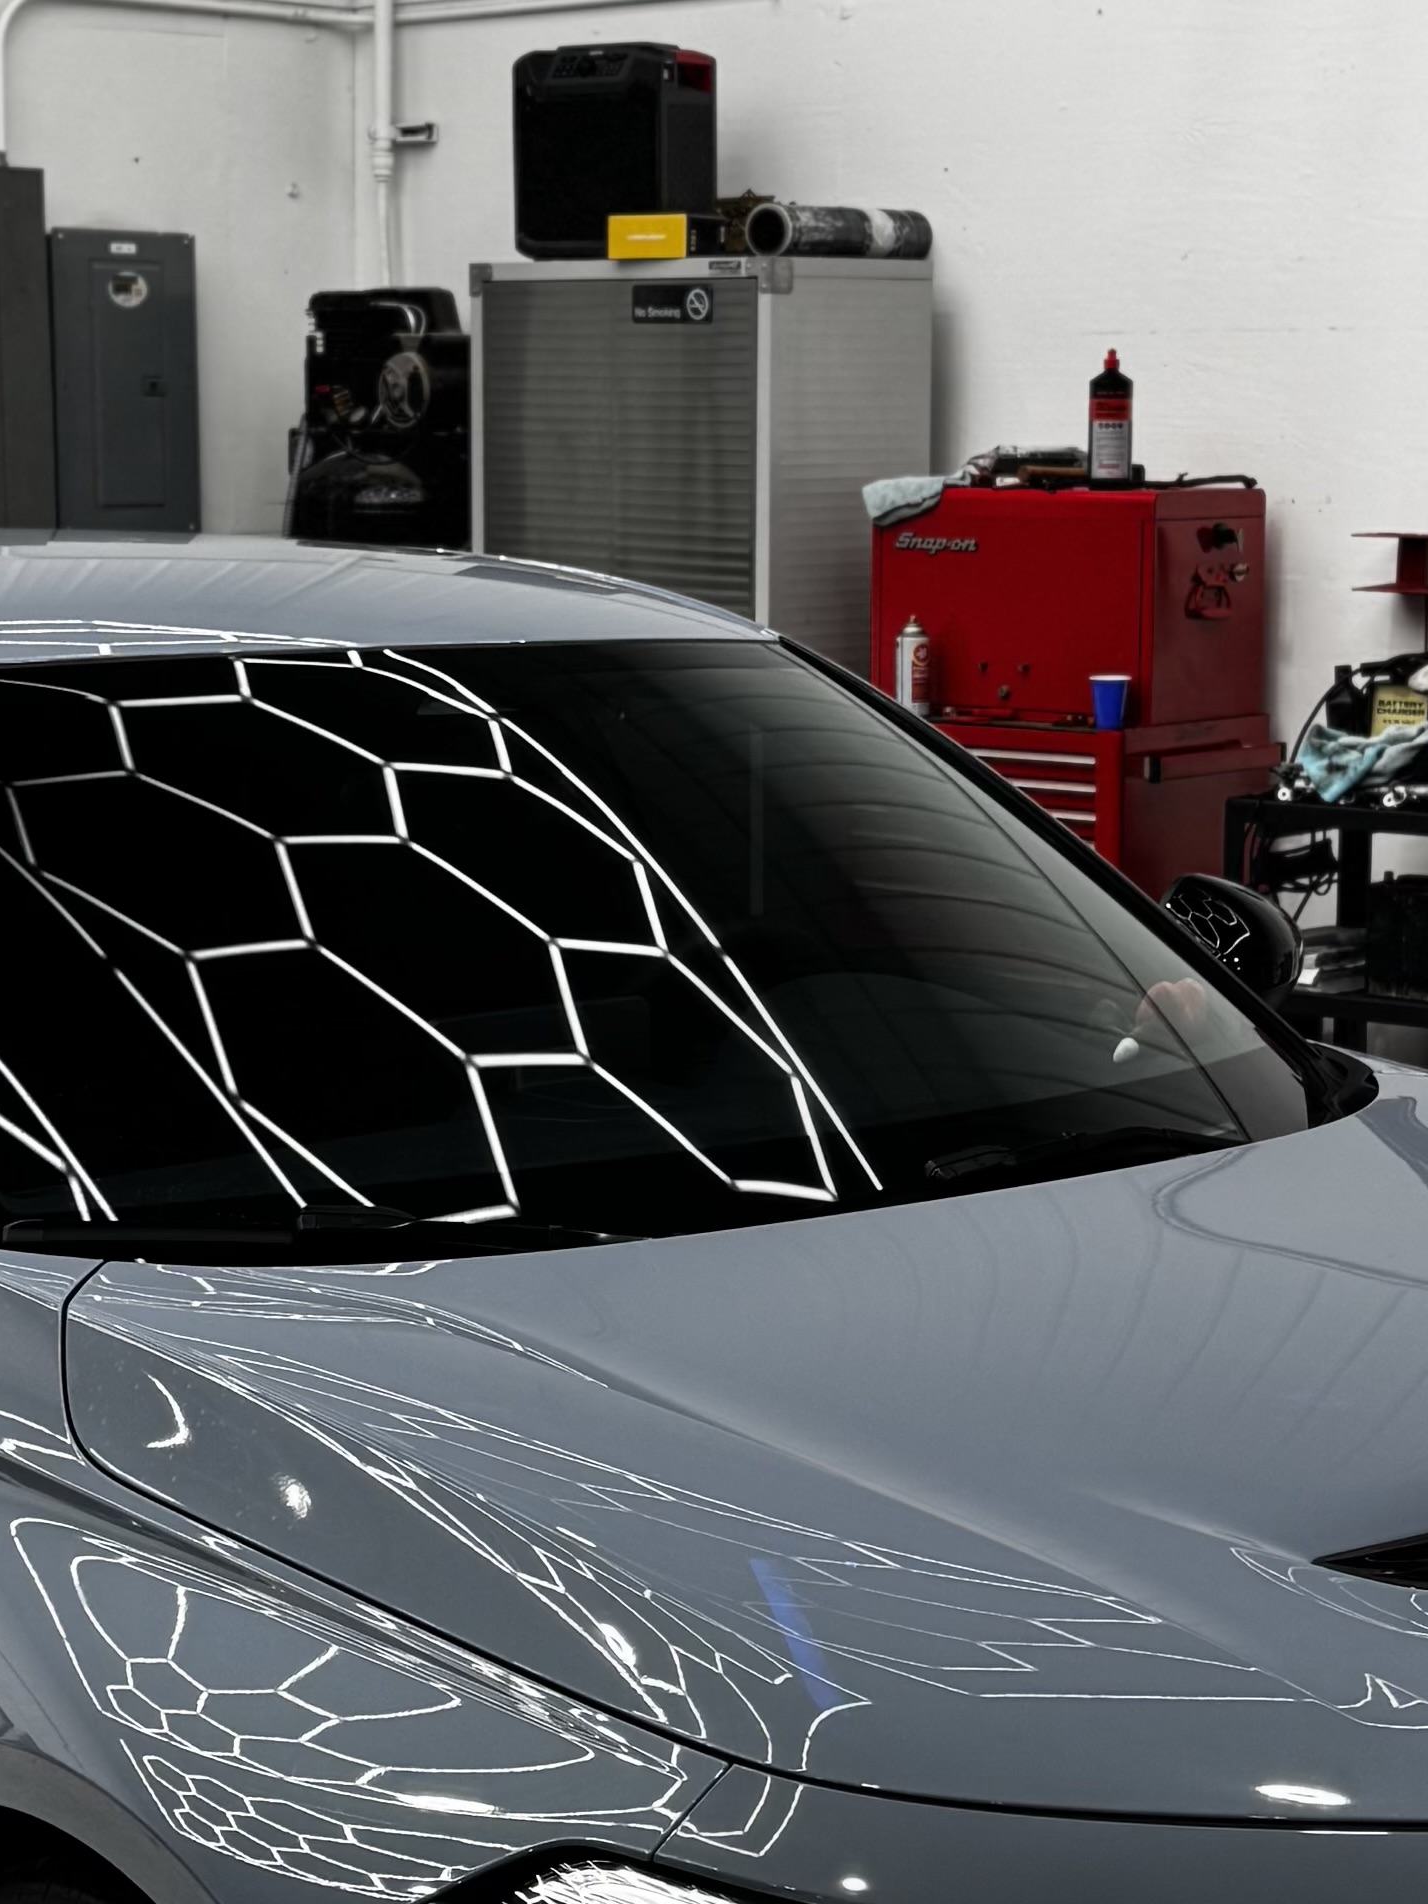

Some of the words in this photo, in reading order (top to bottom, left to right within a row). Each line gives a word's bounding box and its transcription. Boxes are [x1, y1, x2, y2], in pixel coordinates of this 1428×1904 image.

[634, 307, 646, 318] No
[648, 306, 681, 319] Smoking
[896, 532, 977, 555] Snap-on
[1378, 700, 1424, 708] BATTERY
[1377, 708, 1425, 716] CHARGER
